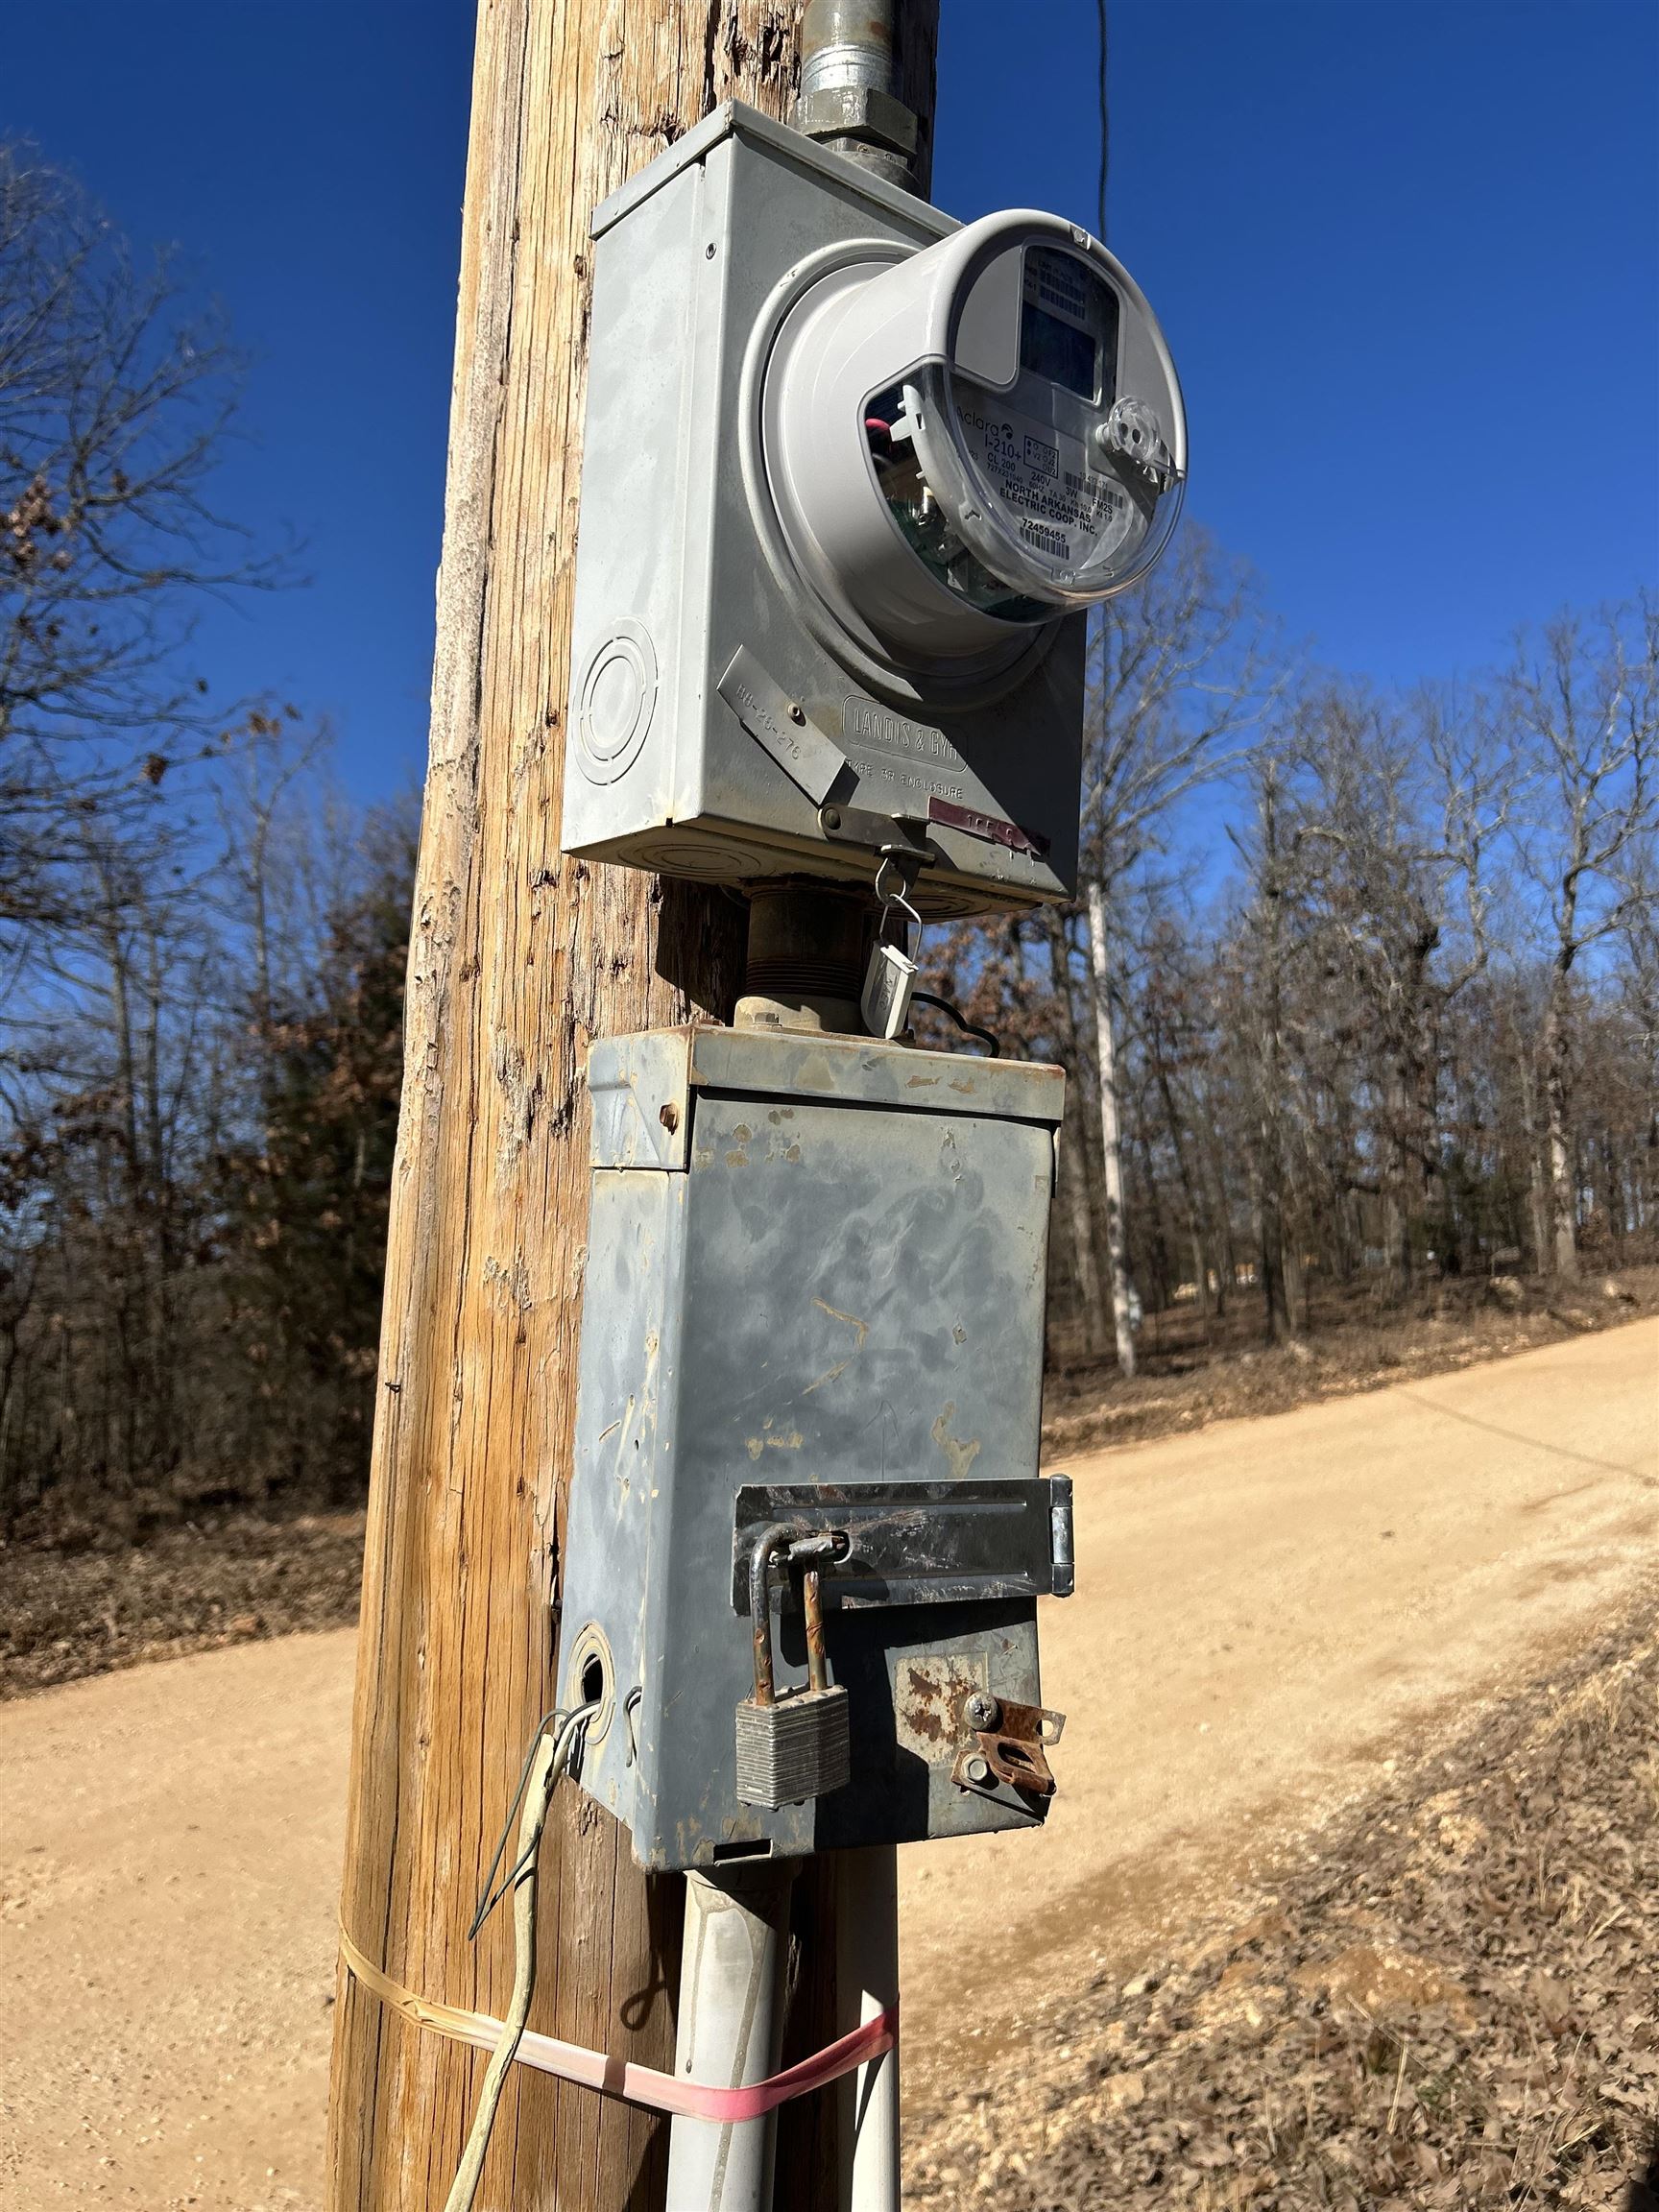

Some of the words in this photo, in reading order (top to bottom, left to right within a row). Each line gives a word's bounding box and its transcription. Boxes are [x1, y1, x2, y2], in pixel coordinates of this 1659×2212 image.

[956, 406, 999, 437] Aclara
[984, 434, 1022, 461] I-210+
[987, 452, 999, 465] CL
[1001, 458, 1016, 472] 200
[1030, 471, 1051, 487] 240V
[1066, 487, 1078, 499] 3W
[999, 488, 1046, 515] ELECTRIC
[1048, 509, 1077, 528] COOP.
[1079, 522, 1098, 537] INC.
[1004, 479, 1039, 501] NORTH
[1041, 494, 1092, 523] ARKANSAS
[1022, 517, 1067, 543] 72459455
[853, 707, 911, 749] LANDIS
[915, 730, 926, 753] &
[900, 774, 965, 801] ENCLOSURE
